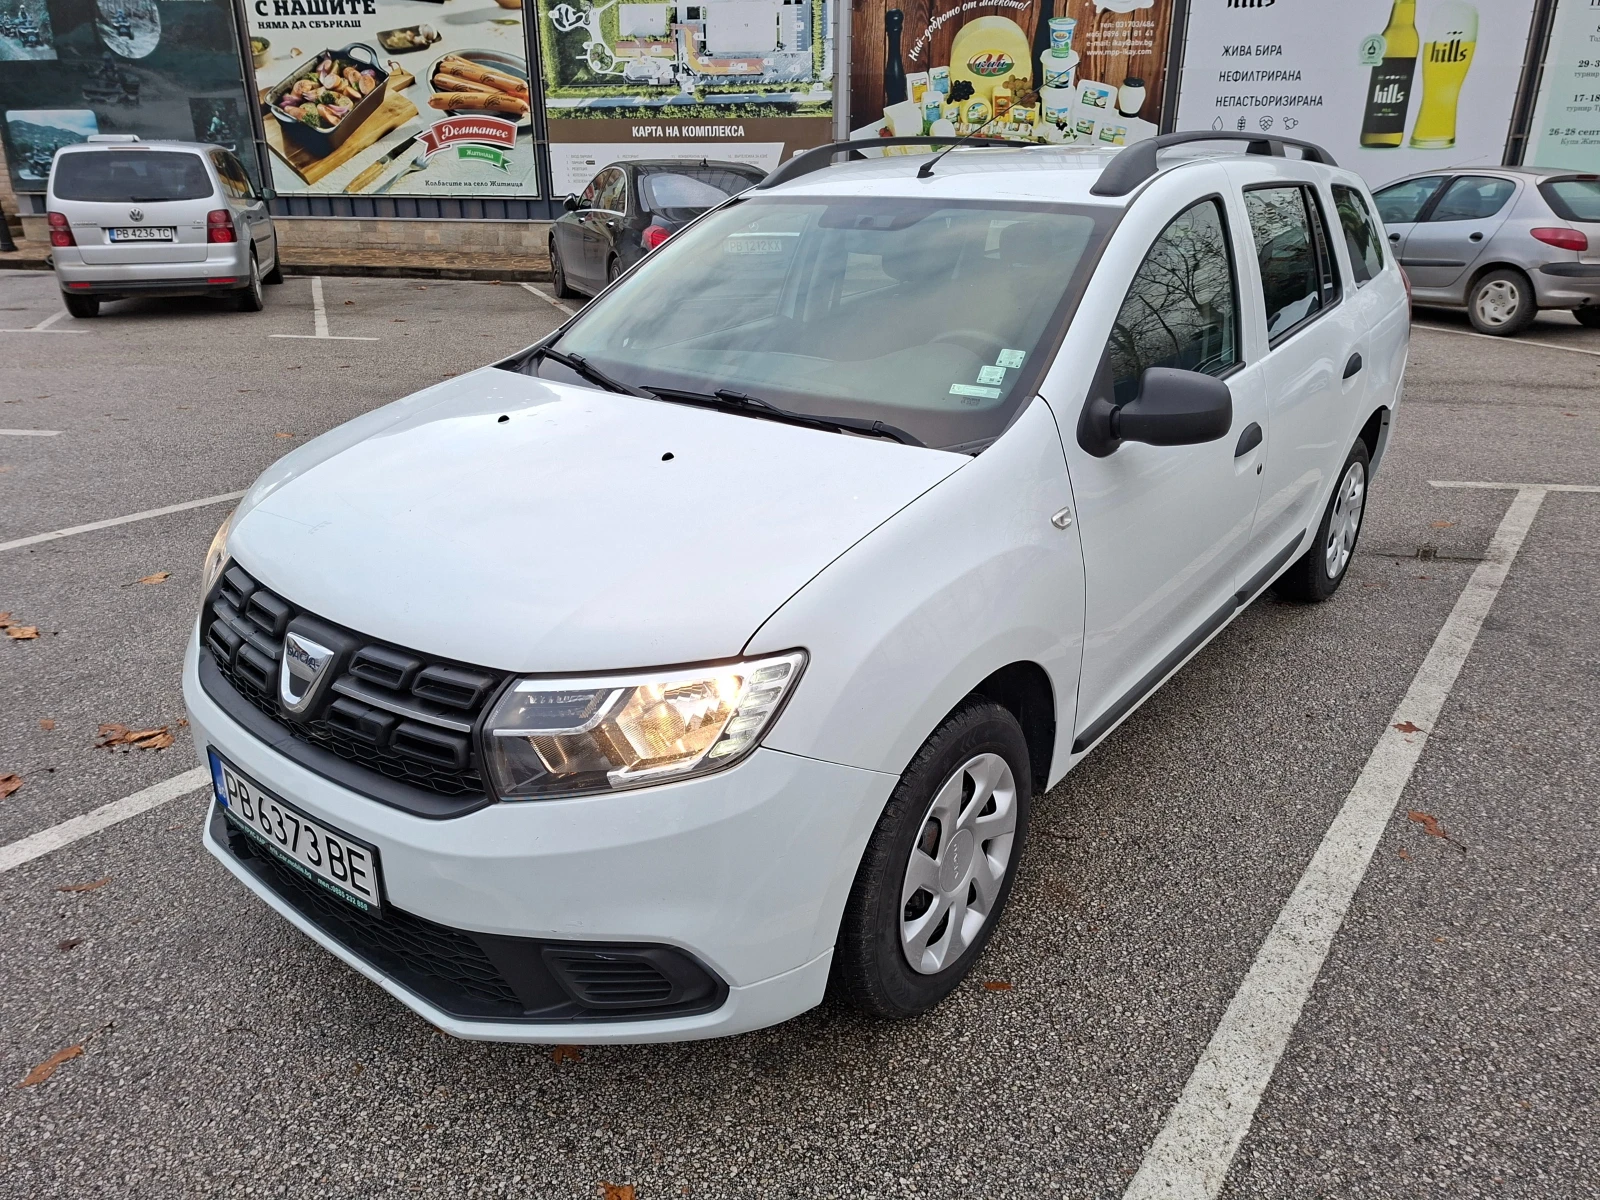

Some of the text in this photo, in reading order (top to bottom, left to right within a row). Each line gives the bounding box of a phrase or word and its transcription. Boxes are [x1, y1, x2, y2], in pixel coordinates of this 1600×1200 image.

[255, 0, 377, 16] С НАШИТЕ
[258, 20, 362, 30] НЯМА ДА СБЪРКАШ
[908, 6, 961, 61] Най-доброто
[962, 1, 977, 11] от
[1222, 45, 1283, 56] ЖИВА БИРА
[1430, 39, 1468, 63] hills
[1218, 70, 1302, 82] НЕФИЛТРИРАНА
[1373, 84, 1405, 104] hills
[1215, 95, 1323, 107] НЕПАСТЬОРИЗИРАНА
[441, 124, 509, 140] Деликатес
[632, 125, 745, 137] КАРТА НА КОМПЛЕКСА
[489, 180, 523, 188] Житница
[116, 228, 170, 239] PB 4236 TC
[223, 767, 371, 897] PB 6373 BE
